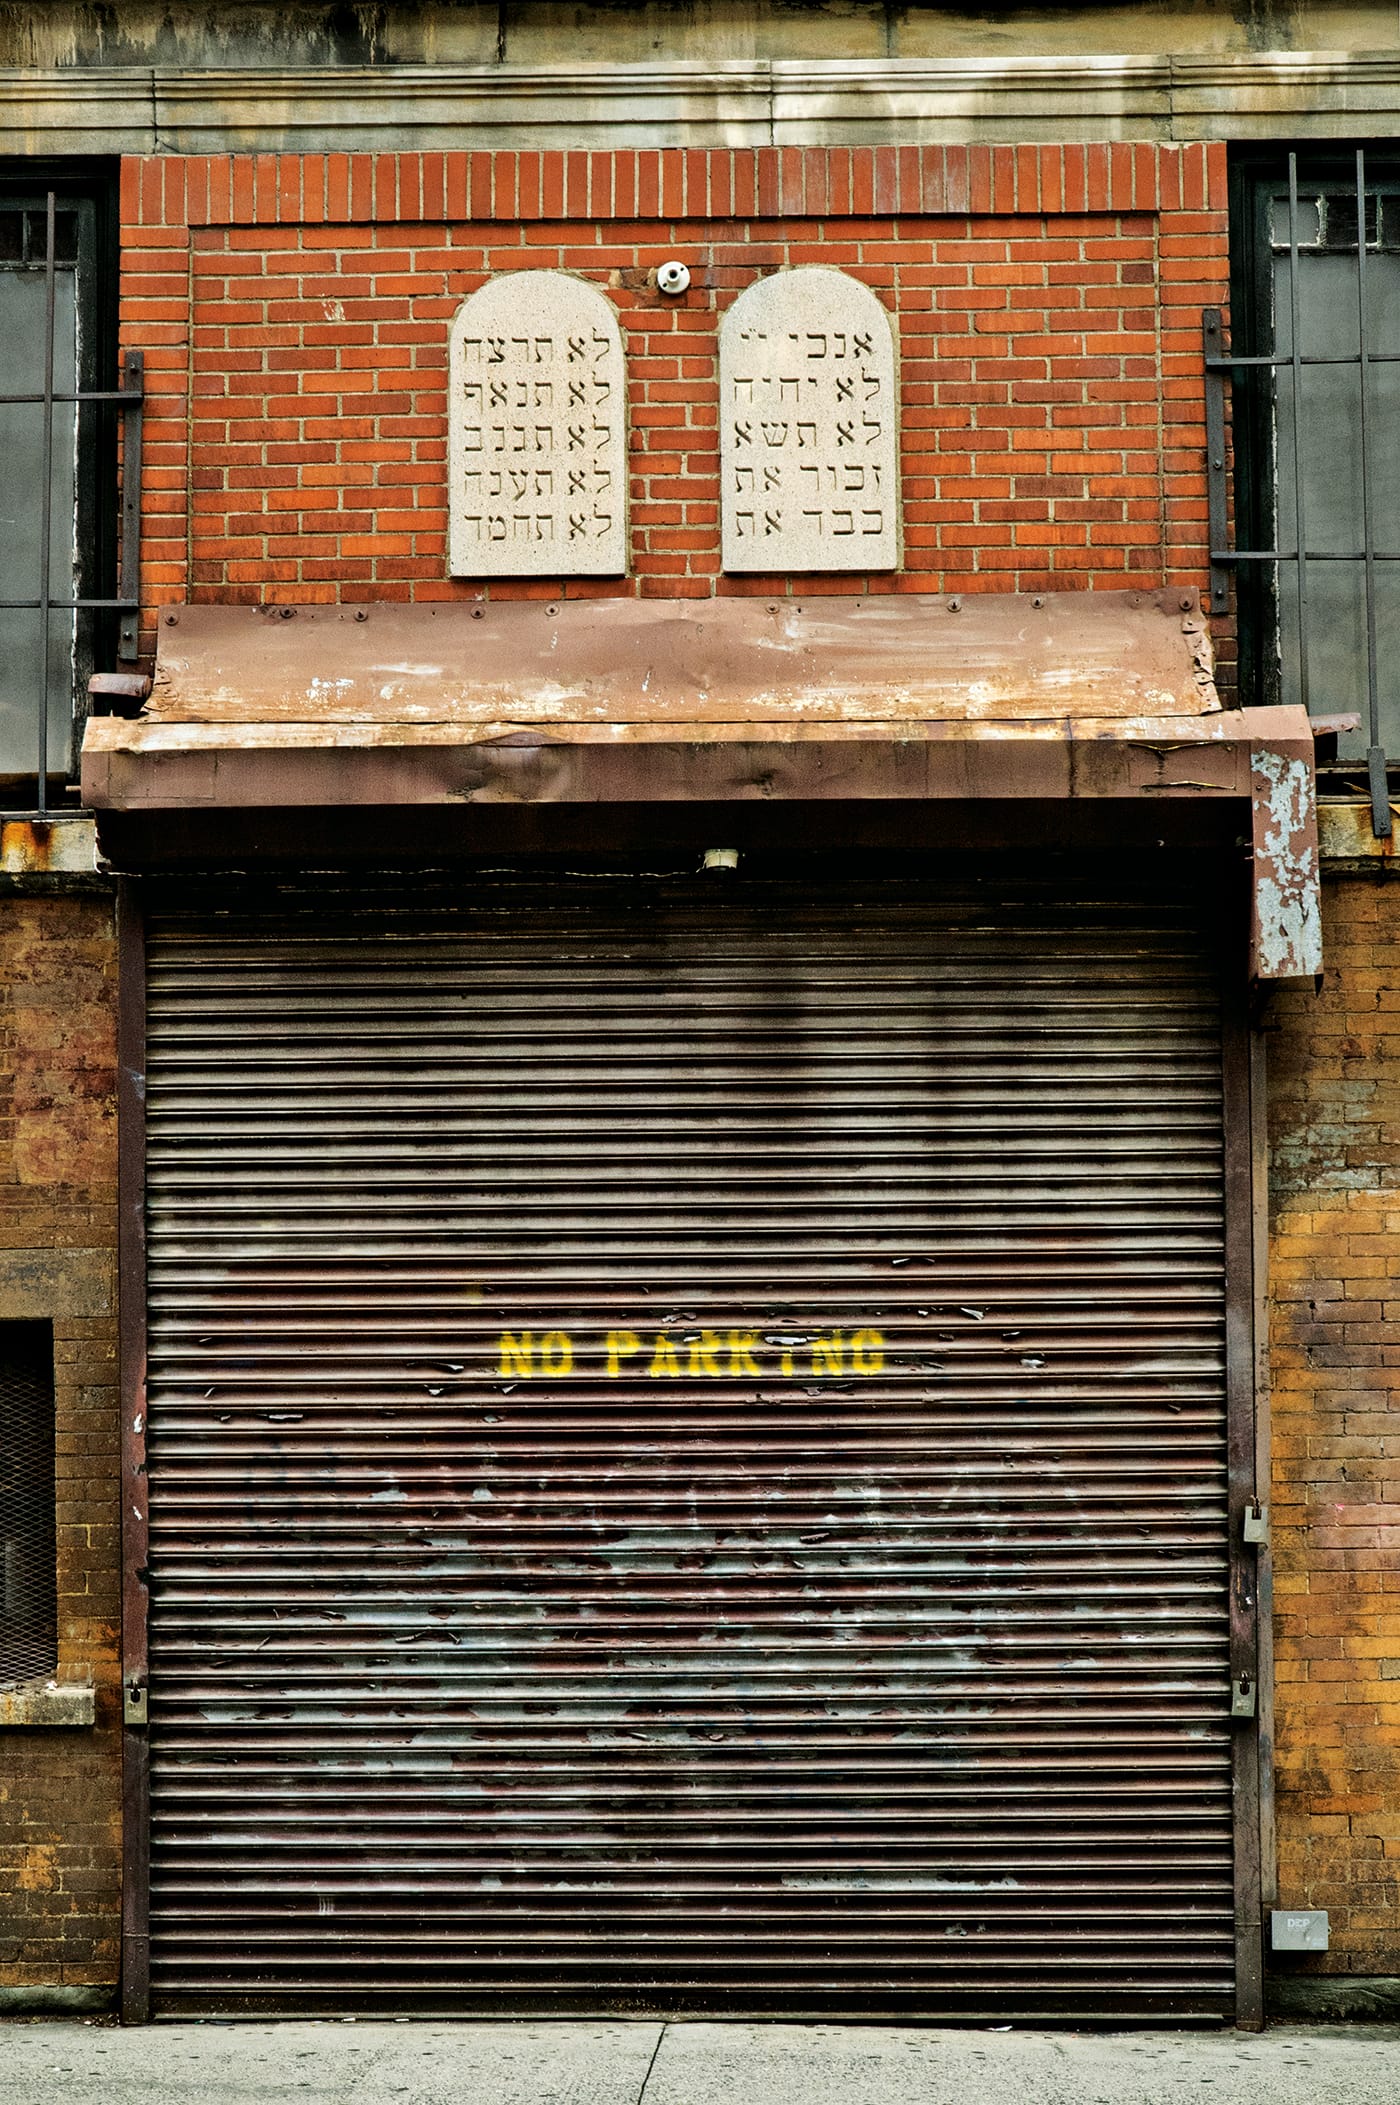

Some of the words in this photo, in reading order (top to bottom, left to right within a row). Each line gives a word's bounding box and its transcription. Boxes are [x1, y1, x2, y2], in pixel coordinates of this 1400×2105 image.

[464, 337, 553, 363] תרצח
[568, 327, 610, 363] לא
[789, 332, 873, 359] אנכי
[464, 381, 553, 415] תנאף
[568, 371, 611, 408] לא
[733, 377, 818, 404] יהיה
[836, 367, 881, 403] לא
[464, 425, 553, 452] תגנב
[568, 414, 611, 452] לא
[734, 420, 817, 449] תשא
[836, 411, 882, 448] לא
[464, 469, 553, 502] תענה
[568, 459, 611, 496] לא
[735, 465, 781, 493] את
[800, 464, 882, 494] זכור
[464, 513, 554, 541] תחמד
[568, 503, 612, 541] לא
[736, 509, 782, 537] את
[802, 509, 883, 537] כבד
[497, 1330, 573, 1378] NO
